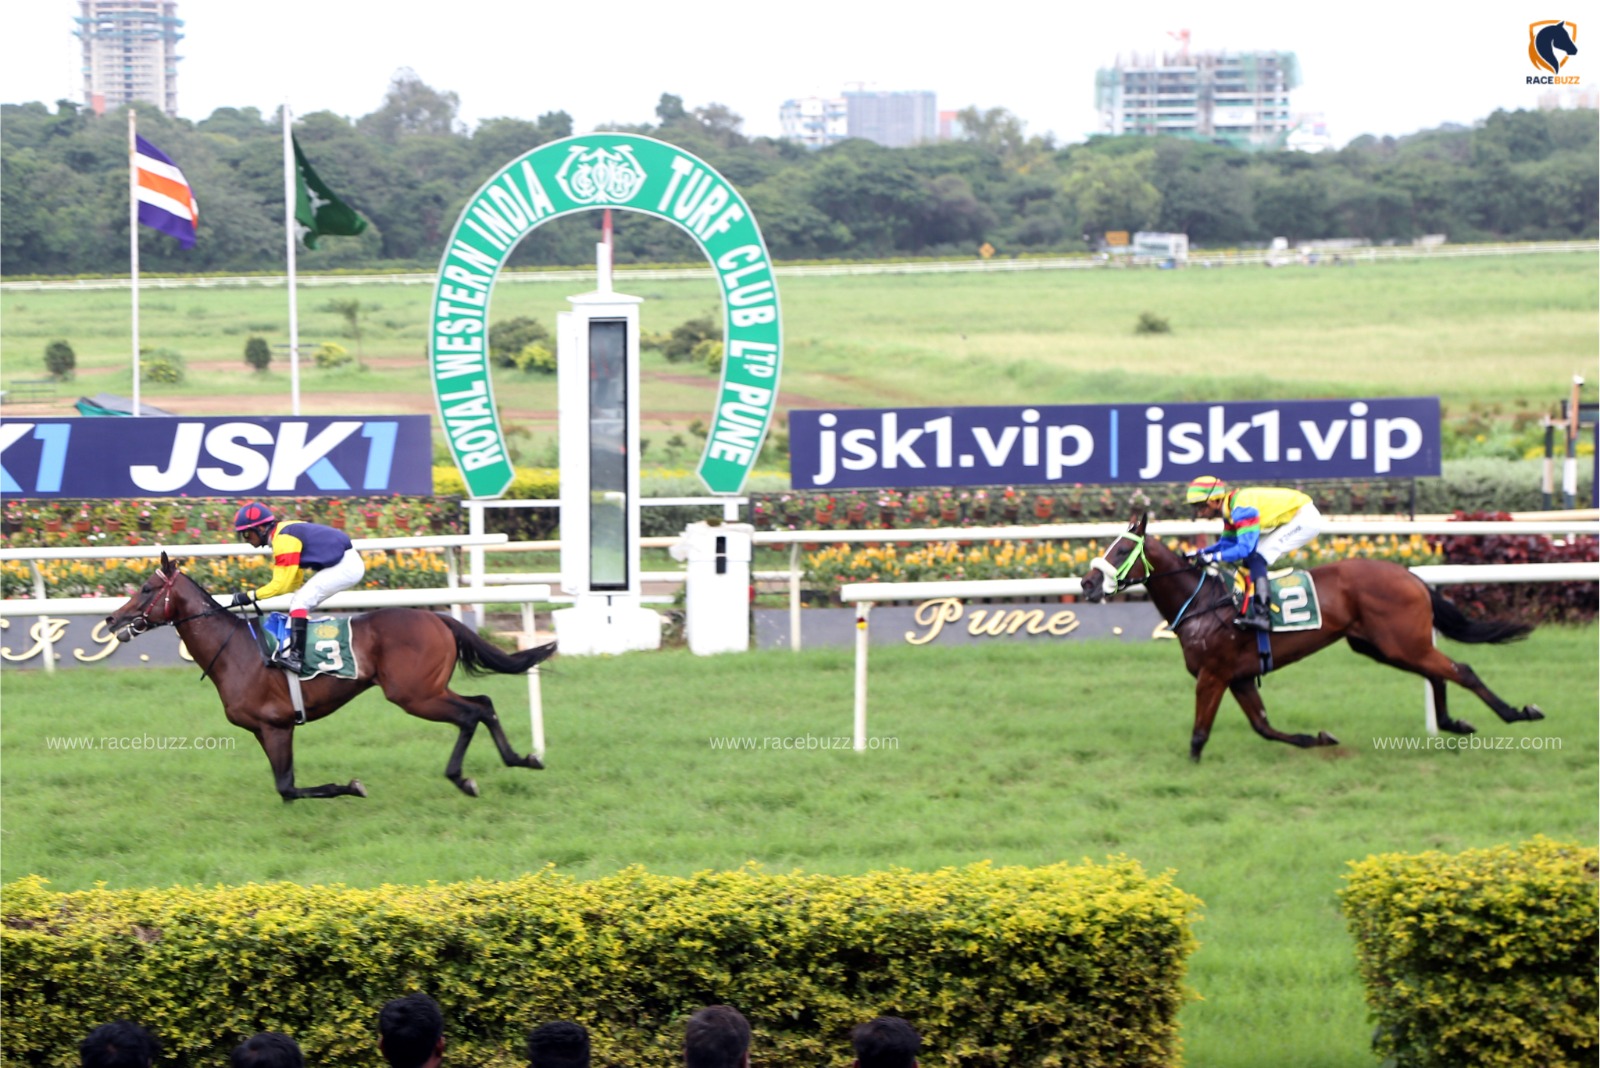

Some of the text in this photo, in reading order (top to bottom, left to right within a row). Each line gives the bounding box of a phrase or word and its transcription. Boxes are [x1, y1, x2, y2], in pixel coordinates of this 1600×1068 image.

[464, 160, 556, 252] INDIA
[657, 155, 745, 242] TURF
[436, 239, 498, 380] WESTERN
[717, 244, 776, 327] CLUB
[129, 422, 399, 492] JSK1
[440, 380, 504, 471] ROYAL
[708, 381, 772, 467] PUNE
[812, 411, 1094, 486] jsk1.vip
[1139, 402, 1423, 480] jsk1.vip
[905, 597, 1081, 645] Pune
[1279, 586, 1311, 624] 2
[315, 639, 344, 671] 3
